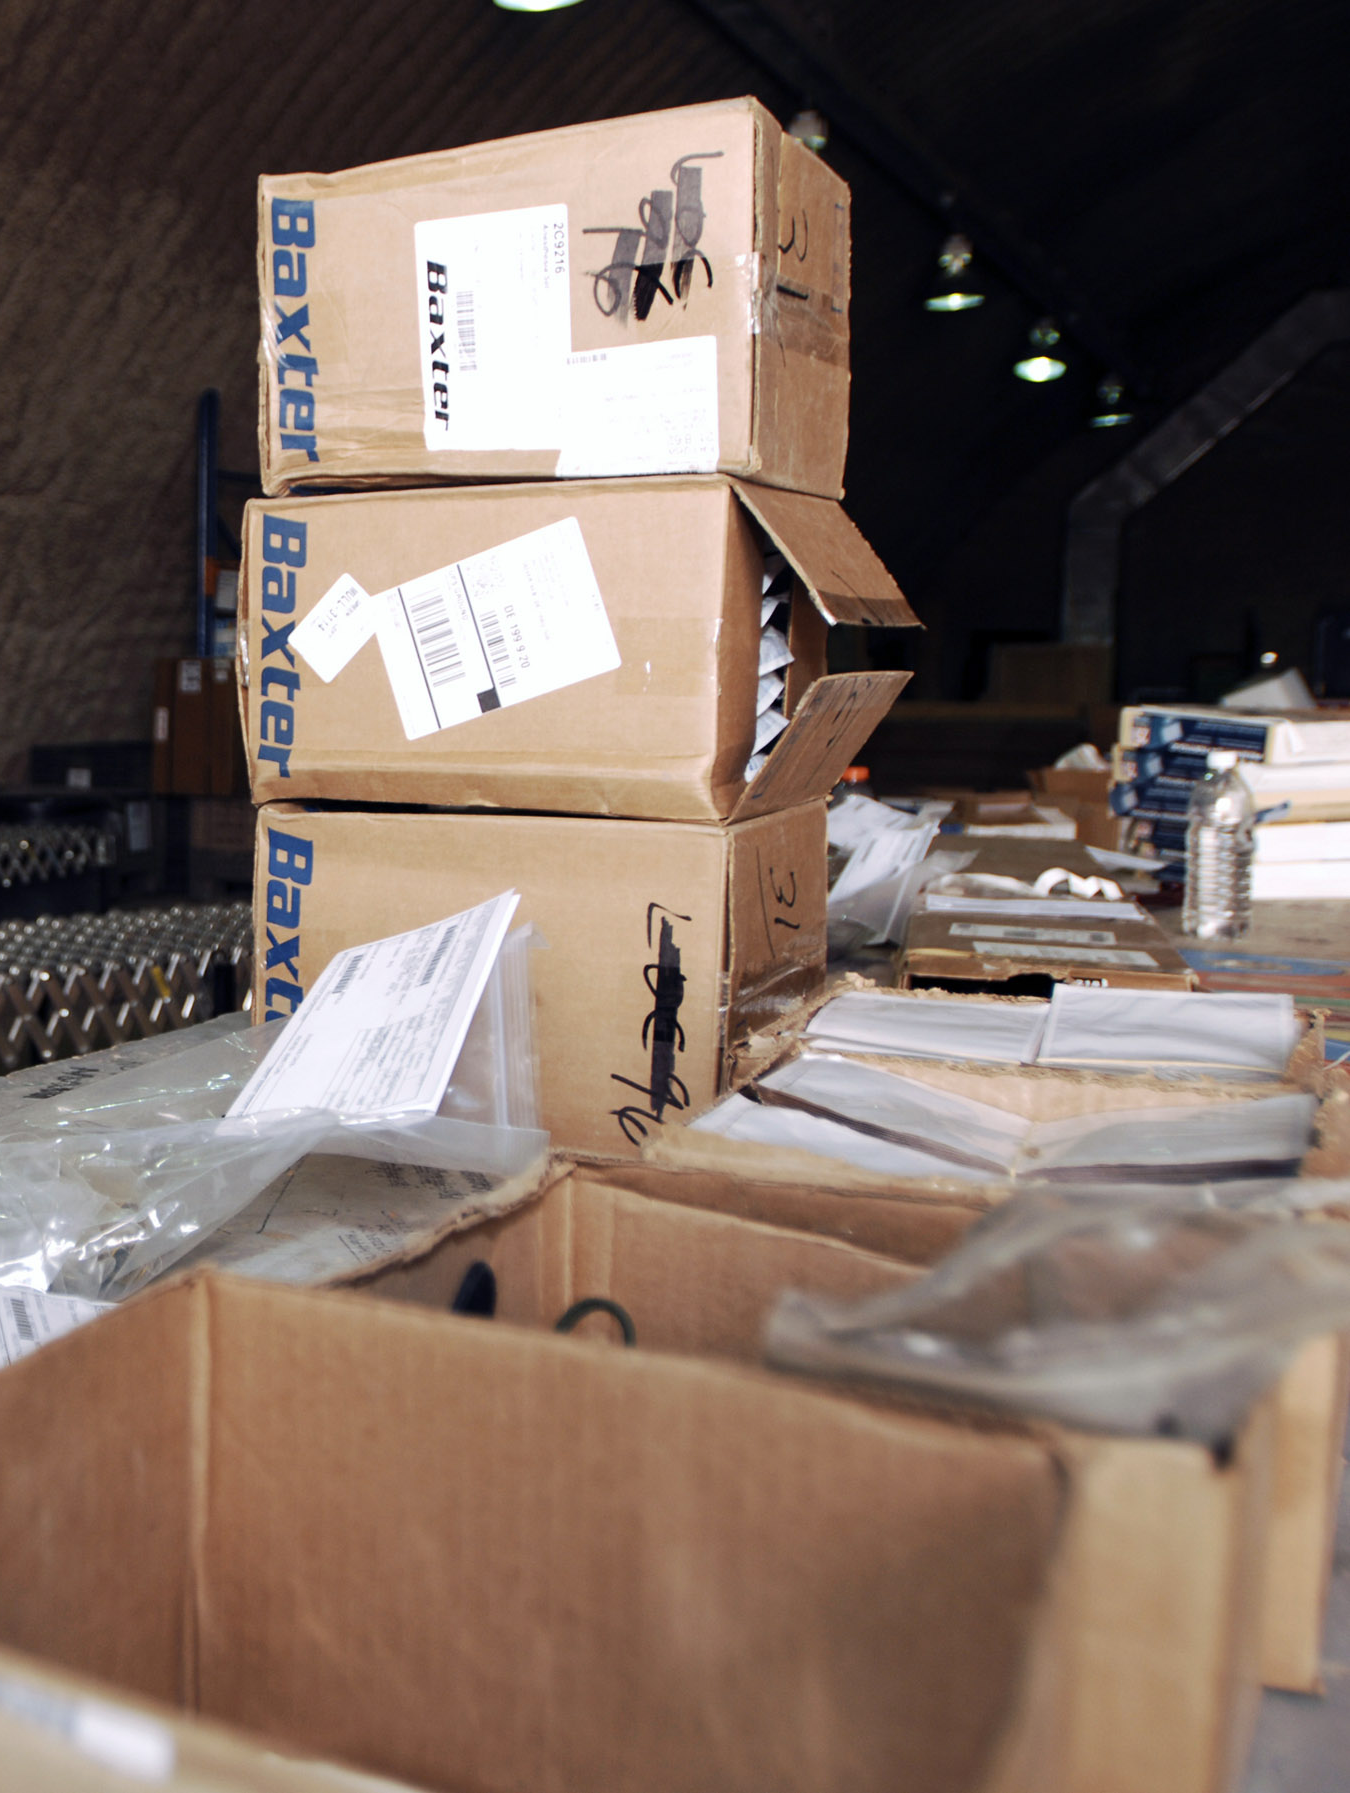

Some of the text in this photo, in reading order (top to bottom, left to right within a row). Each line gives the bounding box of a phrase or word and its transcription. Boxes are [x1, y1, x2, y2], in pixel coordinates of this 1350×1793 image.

[271, 198, 319, 462] Baxter
[425, 258, 449, 431] Baxter
[553, 222, 566, 275] 2C9216
[258, 513, 307, 778] Baxter
[265, 827, 313, 1023] Baxt
